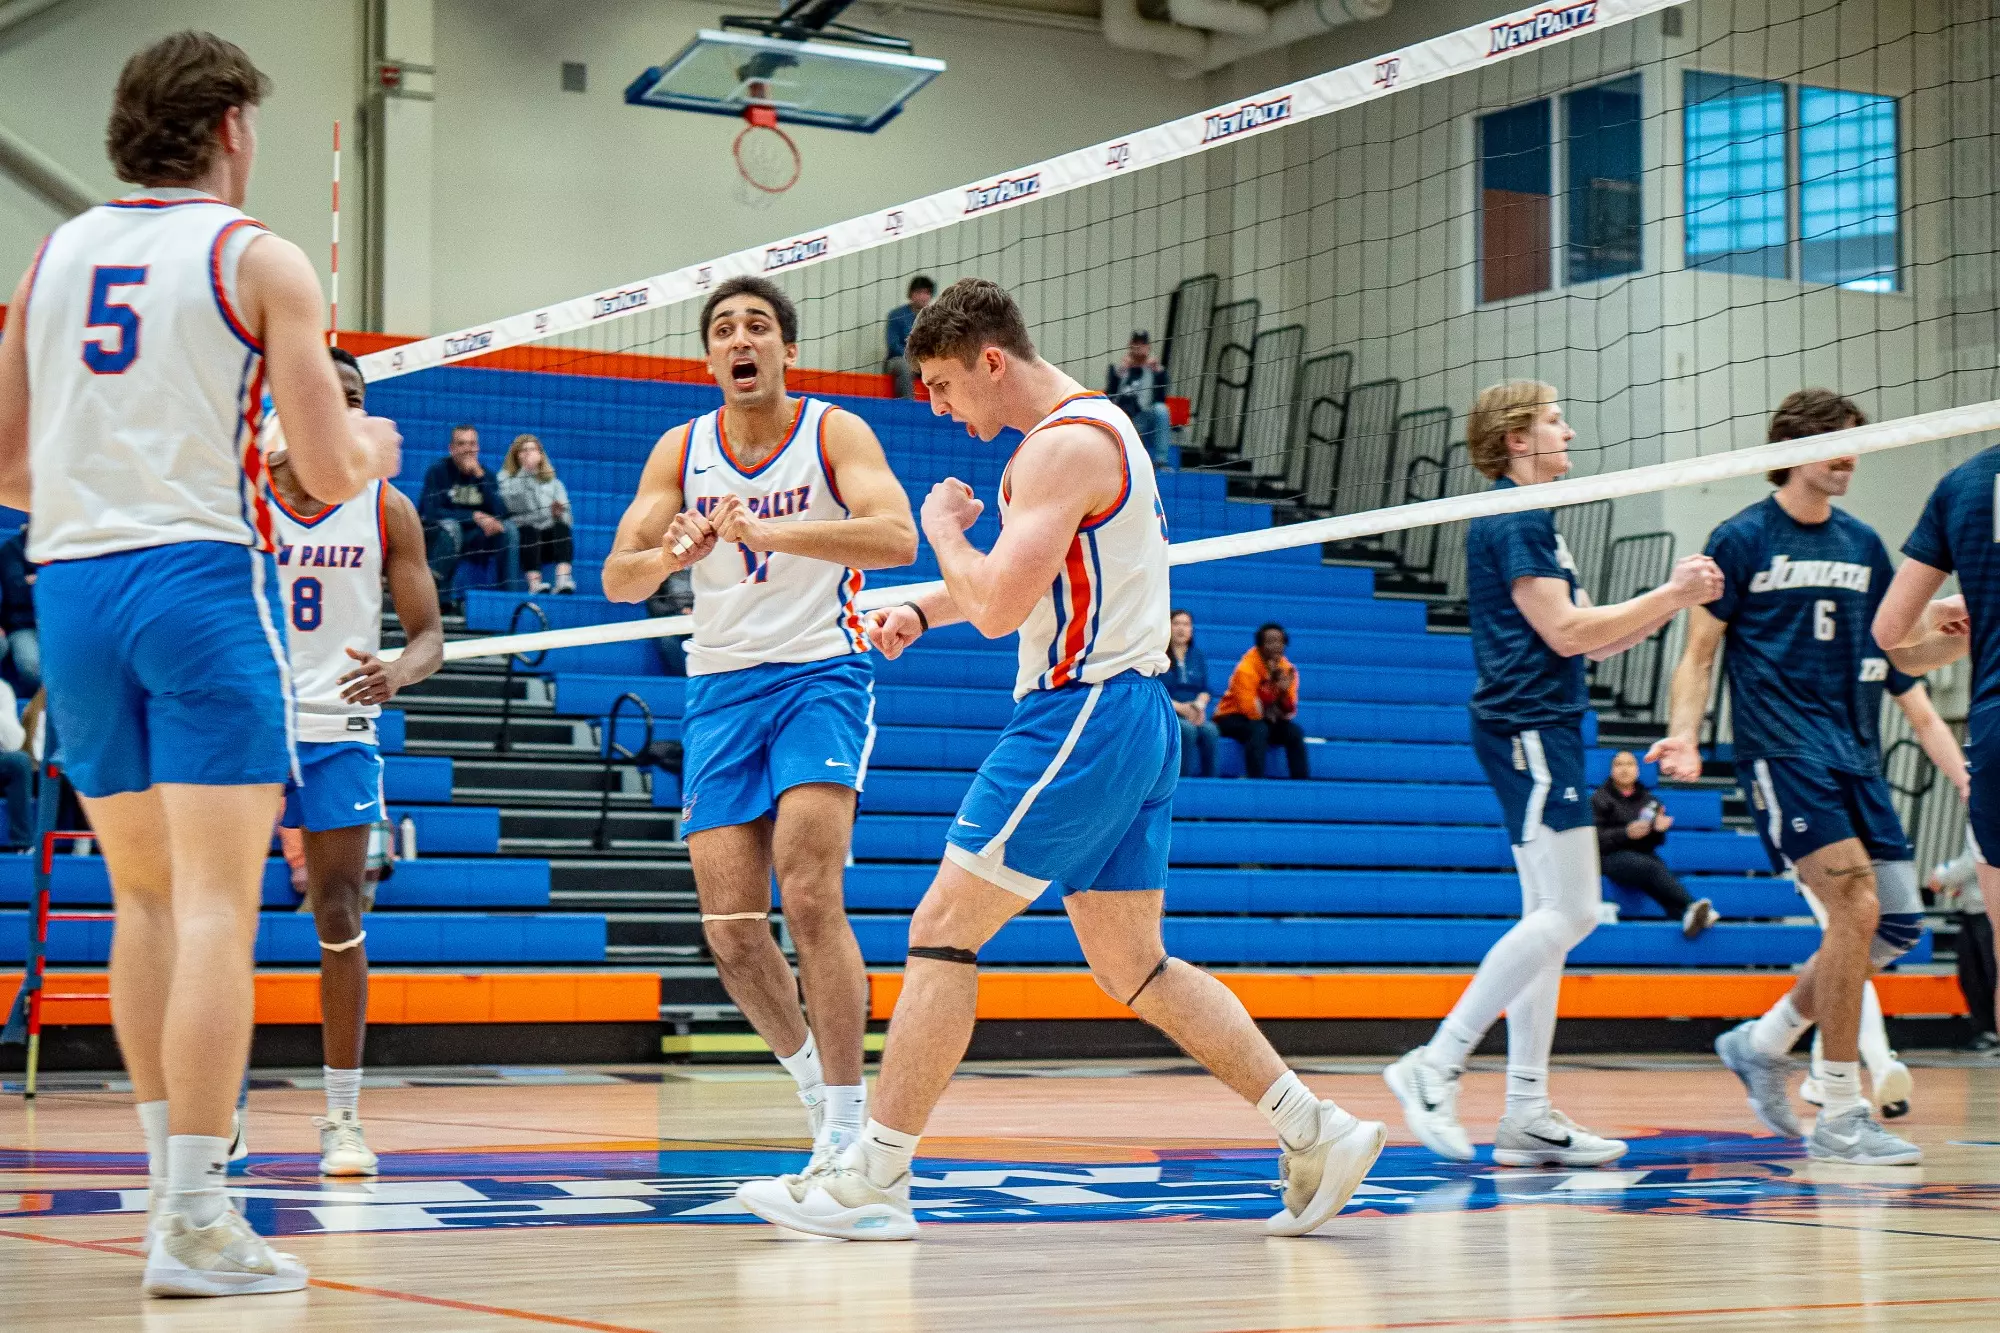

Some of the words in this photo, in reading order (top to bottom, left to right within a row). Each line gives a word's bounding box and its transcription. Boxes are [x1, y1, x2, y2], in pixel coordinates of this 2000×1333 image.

[80, 265, 150, 374] 5
[747, 485, 811, 519] PALTZ
[299, 545, 365, 568] PALTZ
[1748, 554, 1872, 593] JUNIATA
[291, 576, 322, 632] 8
[1813, 599, 1837, 641] 6
